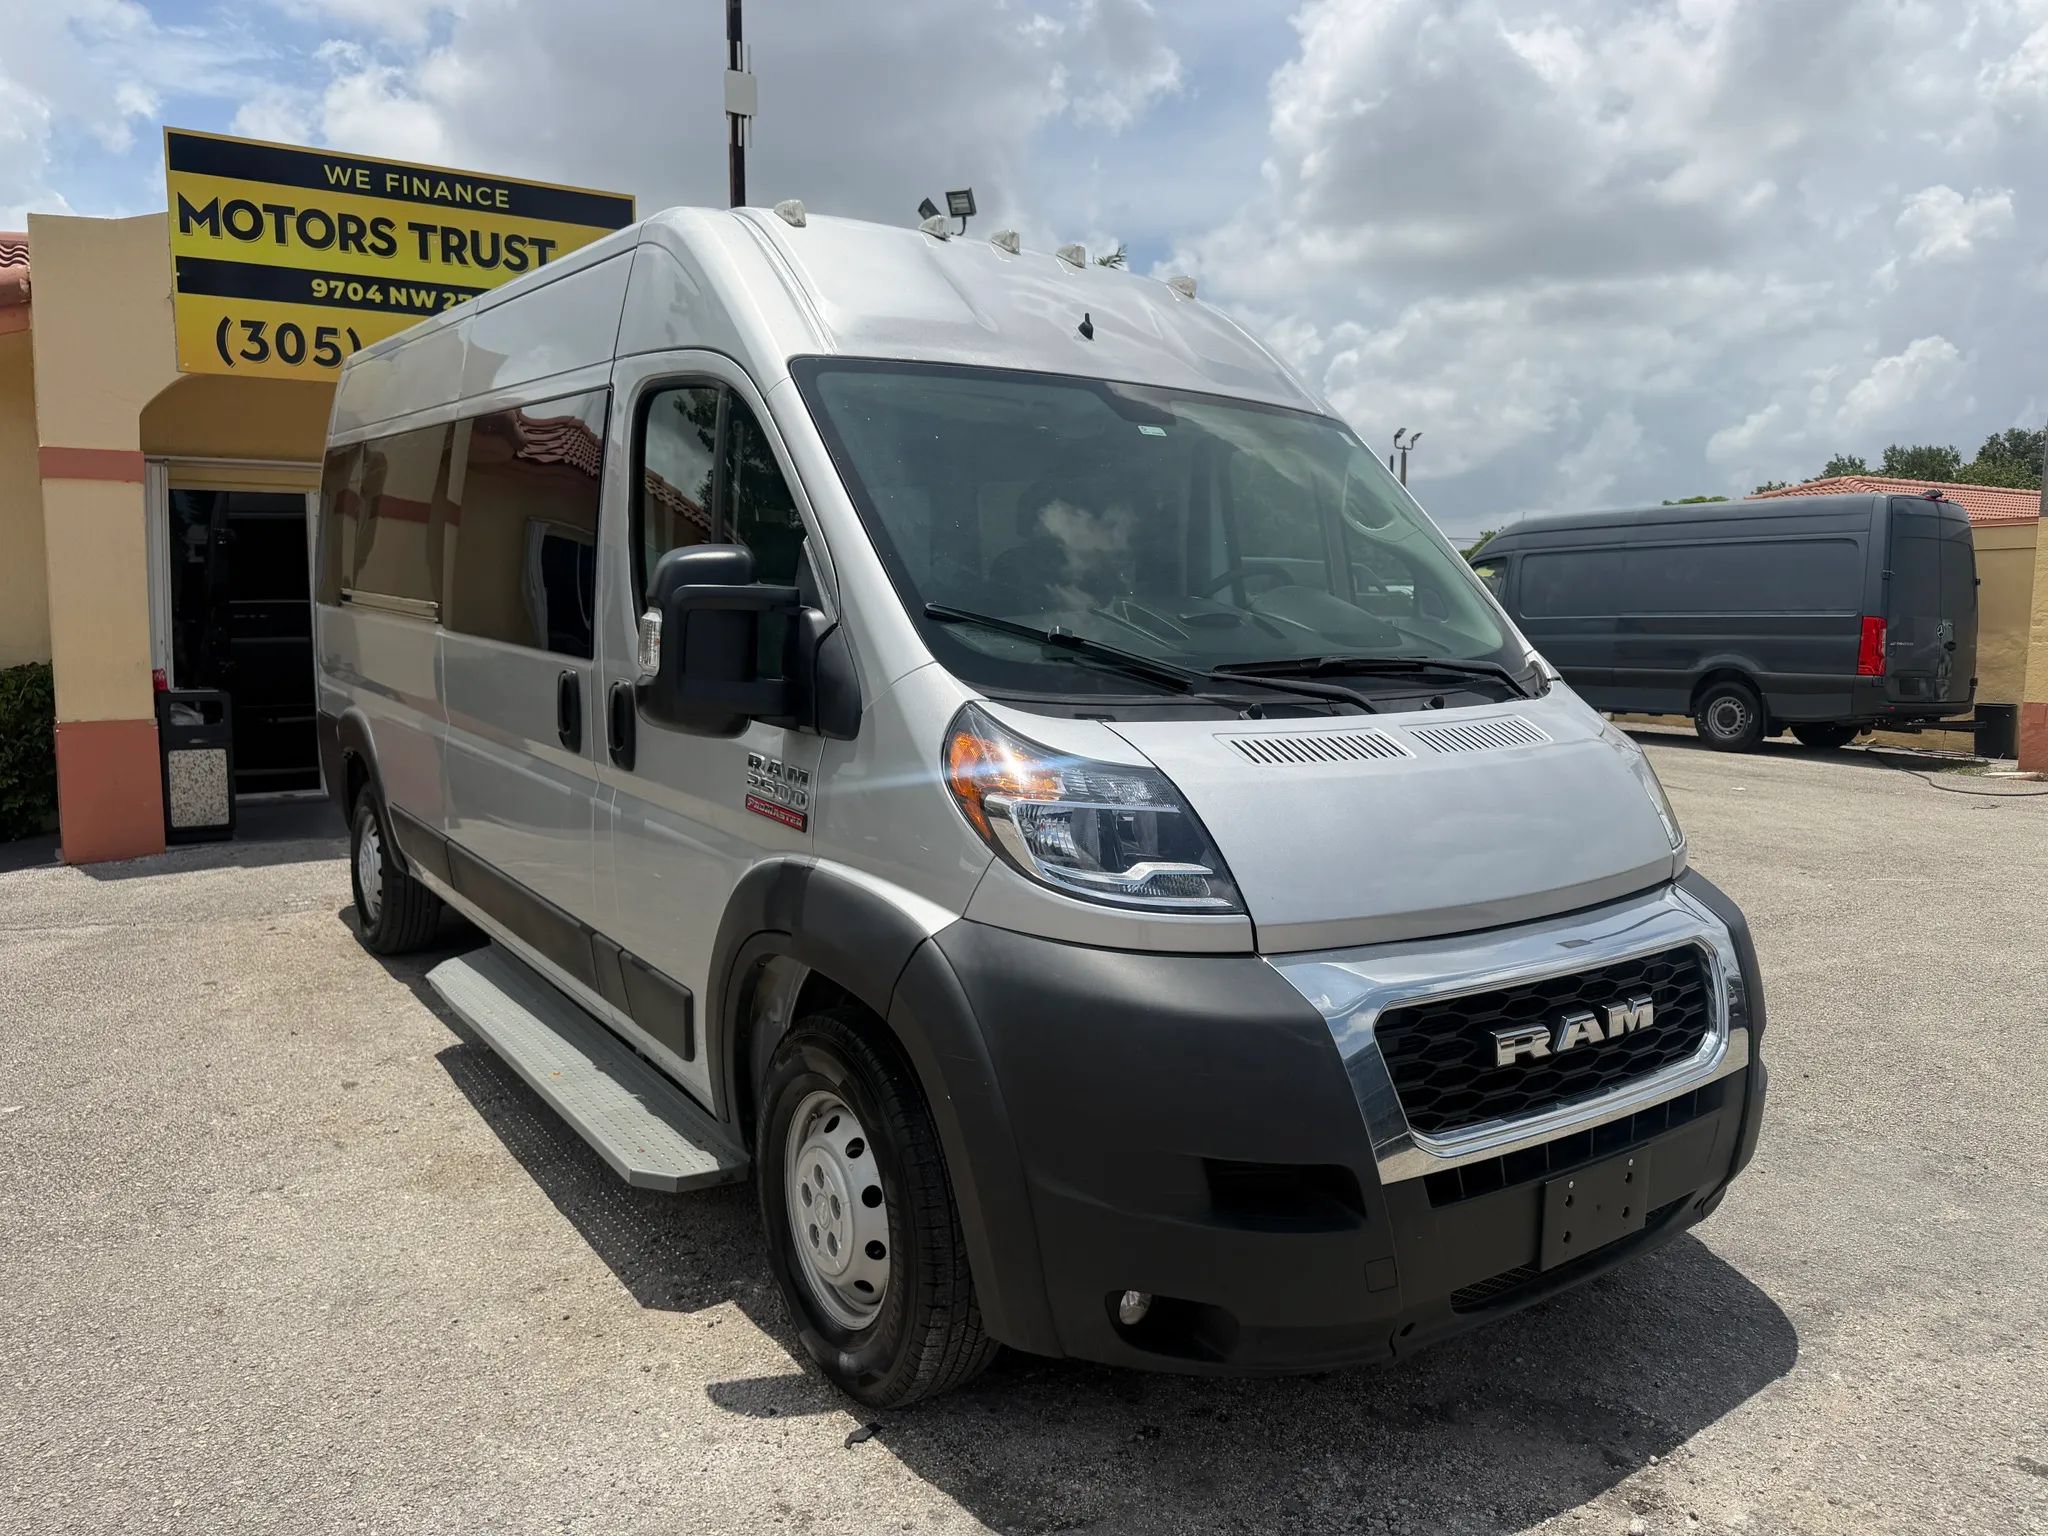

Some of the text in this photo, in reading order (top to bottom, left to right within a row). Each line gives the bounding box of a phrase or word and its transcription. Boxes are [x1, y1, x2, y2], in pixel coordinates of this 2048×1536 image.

[324, 164, 510, 209] WE FINANCE
[177, 191, 557, 273] MOTORS TRUST
[311, 278, 384, 304] 9704
[389, 286, 437, 309] NW
[747, 752, 811, 786] RAM
[1489, 993, 1655, 1068] RAM
